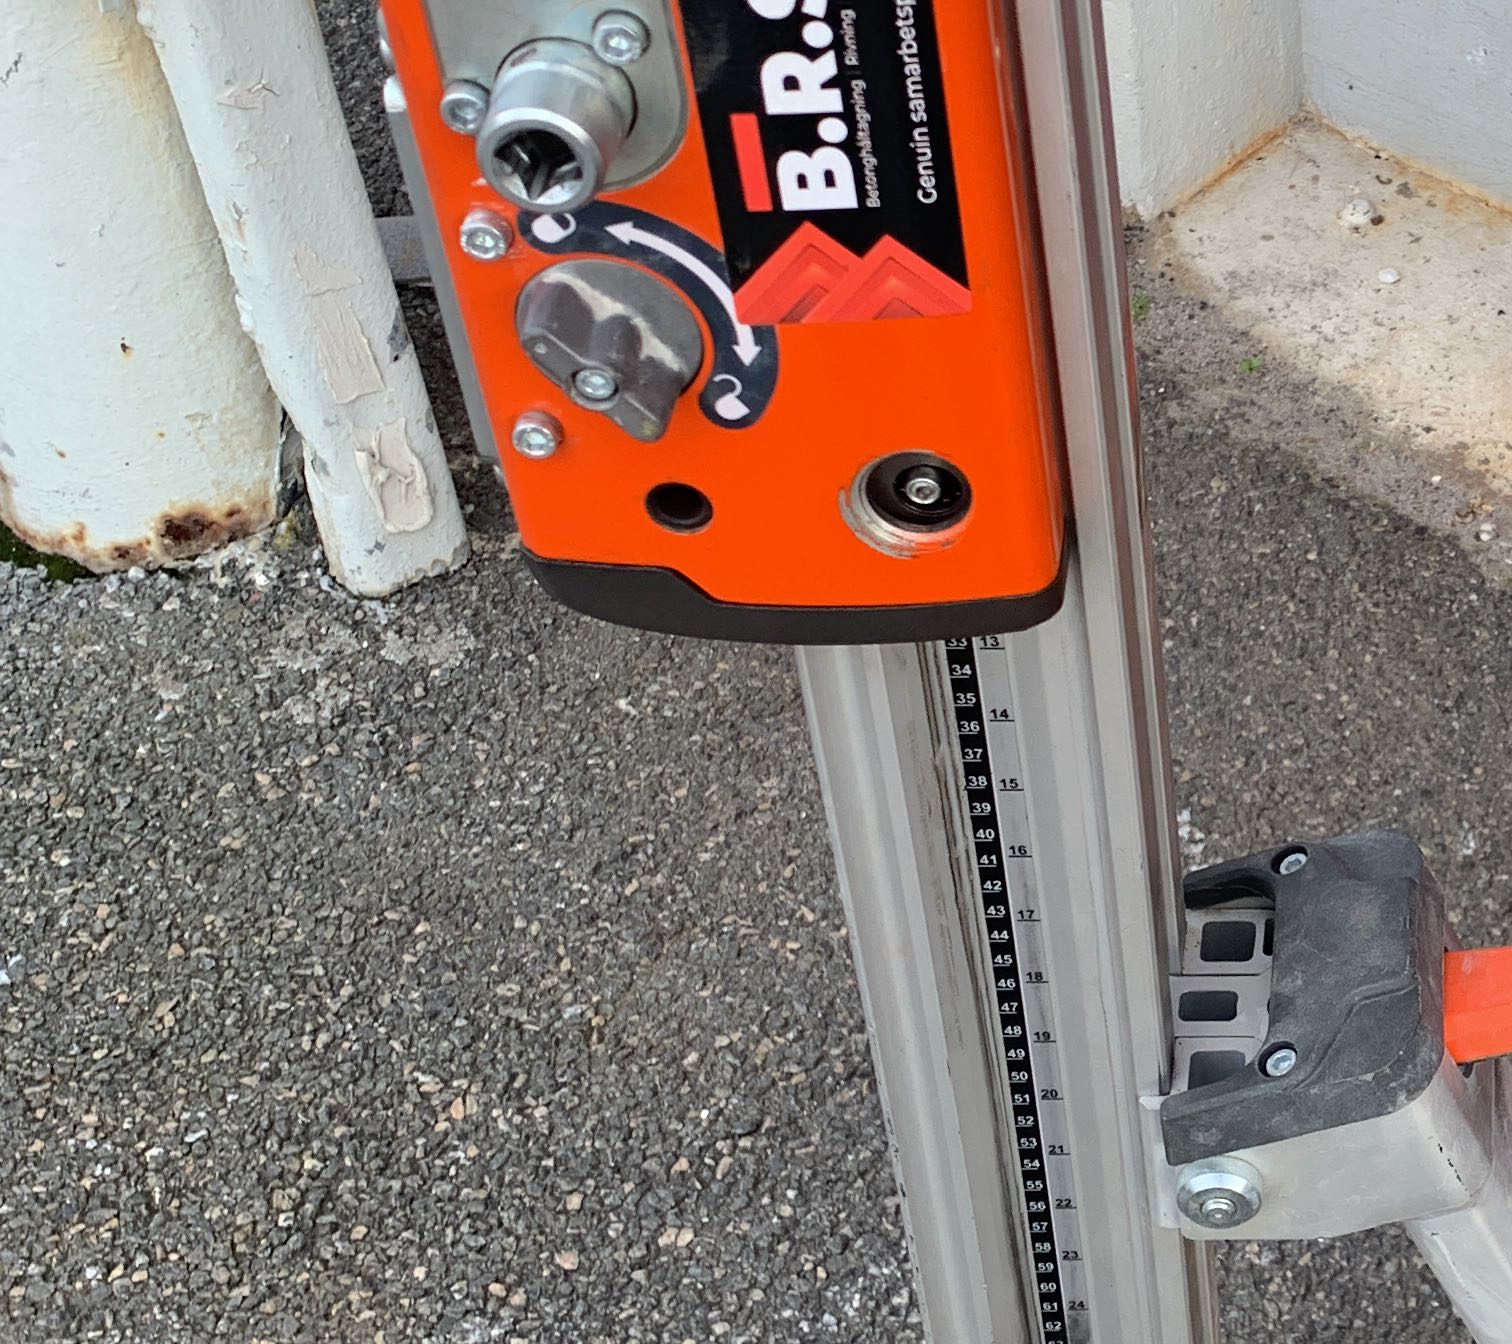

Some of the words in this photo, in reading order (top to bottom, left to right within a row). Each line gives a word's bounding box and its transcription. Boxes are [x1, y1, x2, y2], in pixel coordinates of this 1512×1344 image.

[840, 8, 860, 66] Rivning
[850, 78, 881, 208] Betonghåltagning
[908, 125, 938, 205] Genuin
[979, 636, 1001, 647] 13
[950, 663, 973, 676] 34
[955, 692, 977, 704] 35
[989, 707, 1010, 719] 14
[959, 720, 981, 732] 36
[963, 747, 984, 760] 37
[967, 774, 989, 787] 38
[999, 777, 1020, 789] 15
[971, 801, 992, 813] 39
[974, 827, 996, 839] 40
[1008, 844, 1029, 855] 16
[978, 853, 998, 865] 41
[982, 879, 1003, 891] 42
[985, 904, 1007, 916] 43
[1017, 909, 1035, 919] 17
[989, 929, 1010, 940] 44
[993, 953, 1014, 965] 45
[1025, 970, 1044, 981] 18
[996, 977, 1017, 989] 46
[1000, 1001, 1020, 1012] 47
[1003, 1024, 1024, 1035] 48
[1033, 1030, 1052, 1041] 19
[1006, 1047, 1026, 1058] 49
[1010, 1070, 1029, 1081] 50
[1013, 1093, 1031, 1103] 51
[1040, 1088, 1060, 1099] 20
[1016, 1114, 1036, 1125] 52
[1019, 1136, 1039, 1147] 53
[1047, 1144, 1066, 1154] 21
[1022, 1158, 1042, 1169] 54
[1025, 1179, 1045, 1190] 55
[1028, 1200, 1047, 1210] 56
[1054, 1197, 1073, 1207] 22
[1031, 1221, 1049, 1231] 57
[1034, 1241, 1052, 1251] 58
[1061, 1249, 1080, 1259] 23
[1036, 1261, 1055, 1271] 59
[1039, 1281, 1058, 1291] 60
[1042, 1301, 1059, 1311] 61
[1067, 1299, 1086, 1309] 24
[1044, 1320, 1063, 1330] 62
